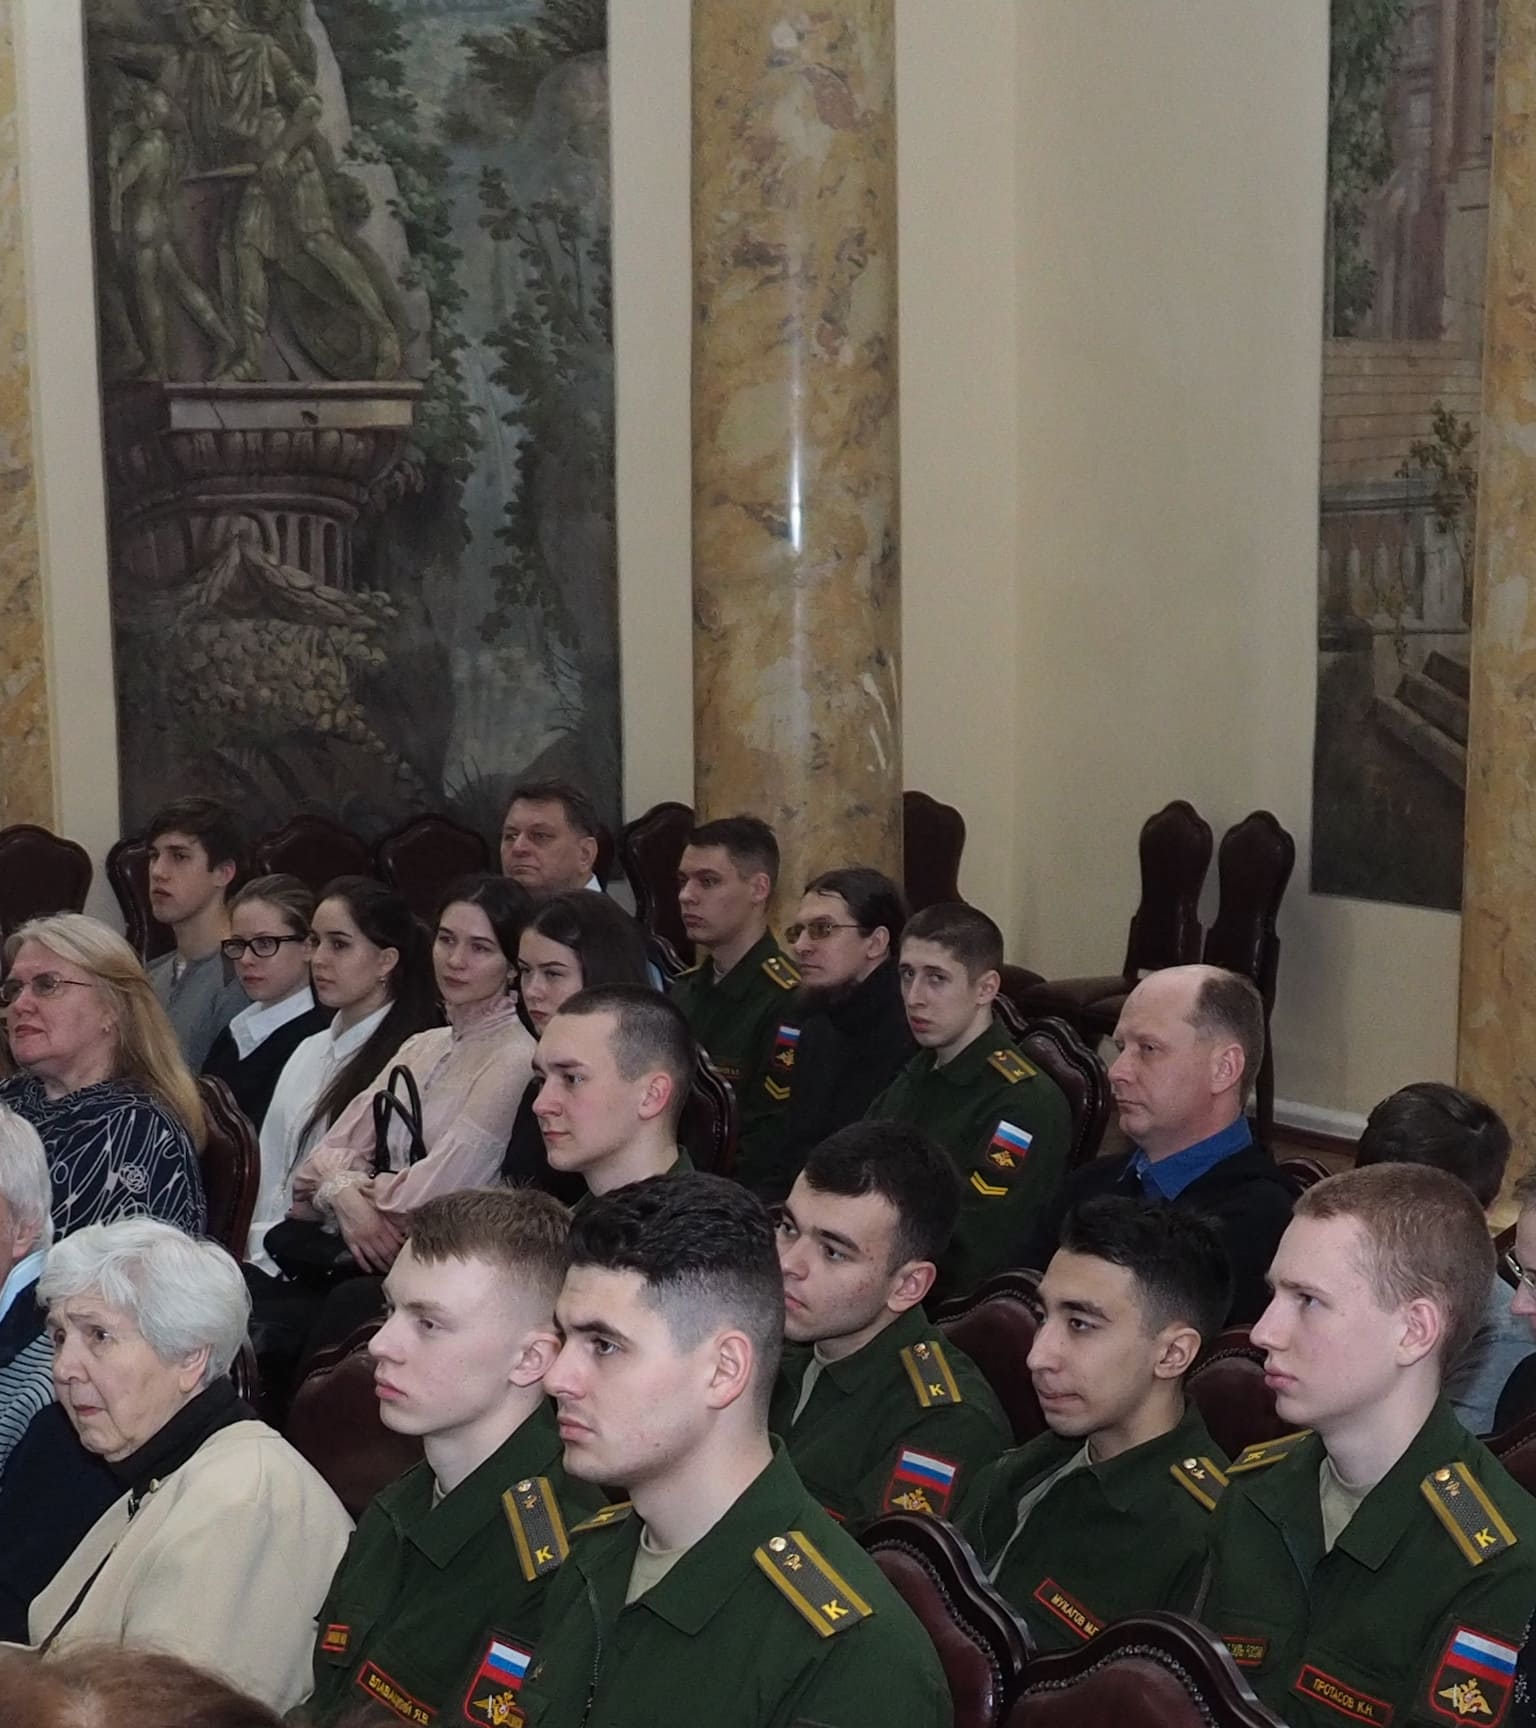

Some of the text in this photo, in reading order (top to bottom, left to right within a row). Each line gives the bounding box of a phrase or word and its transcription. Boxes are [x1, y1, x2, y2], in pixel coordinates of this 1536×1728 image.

[928, 1382, 945, 1397] К
[1475, 1528, 1496, 1548] К
[536, 1545, 553, 1564] К
[822, 1600, 848, 1620] К
[1312, 1677, 1355, 1709] ПРОТАСОВ
